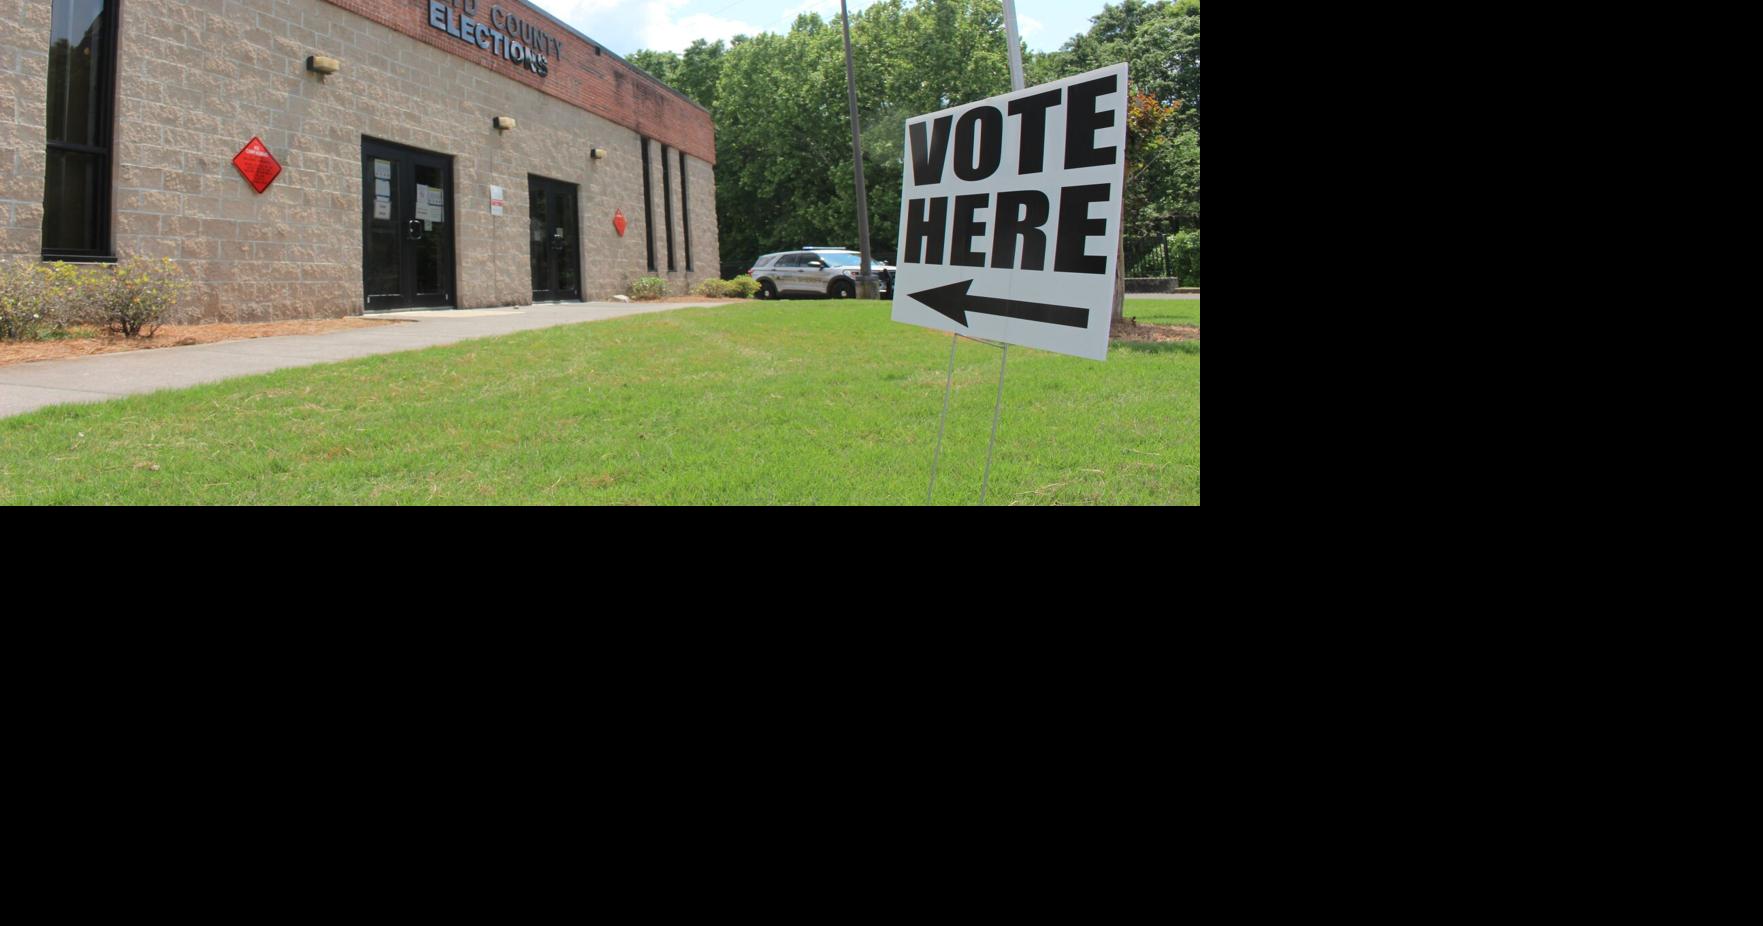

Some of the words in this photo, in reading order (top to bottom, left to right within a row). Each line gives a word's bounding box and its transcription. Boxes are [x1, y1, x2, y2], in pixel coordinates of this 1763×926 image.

[428, 0, 548, 78] ELECTIONS
[491, 4, 563, 61] COUNTY
[909, 74, 1118, 187] VOTE
[904, 183, 1111, 275] HERE
